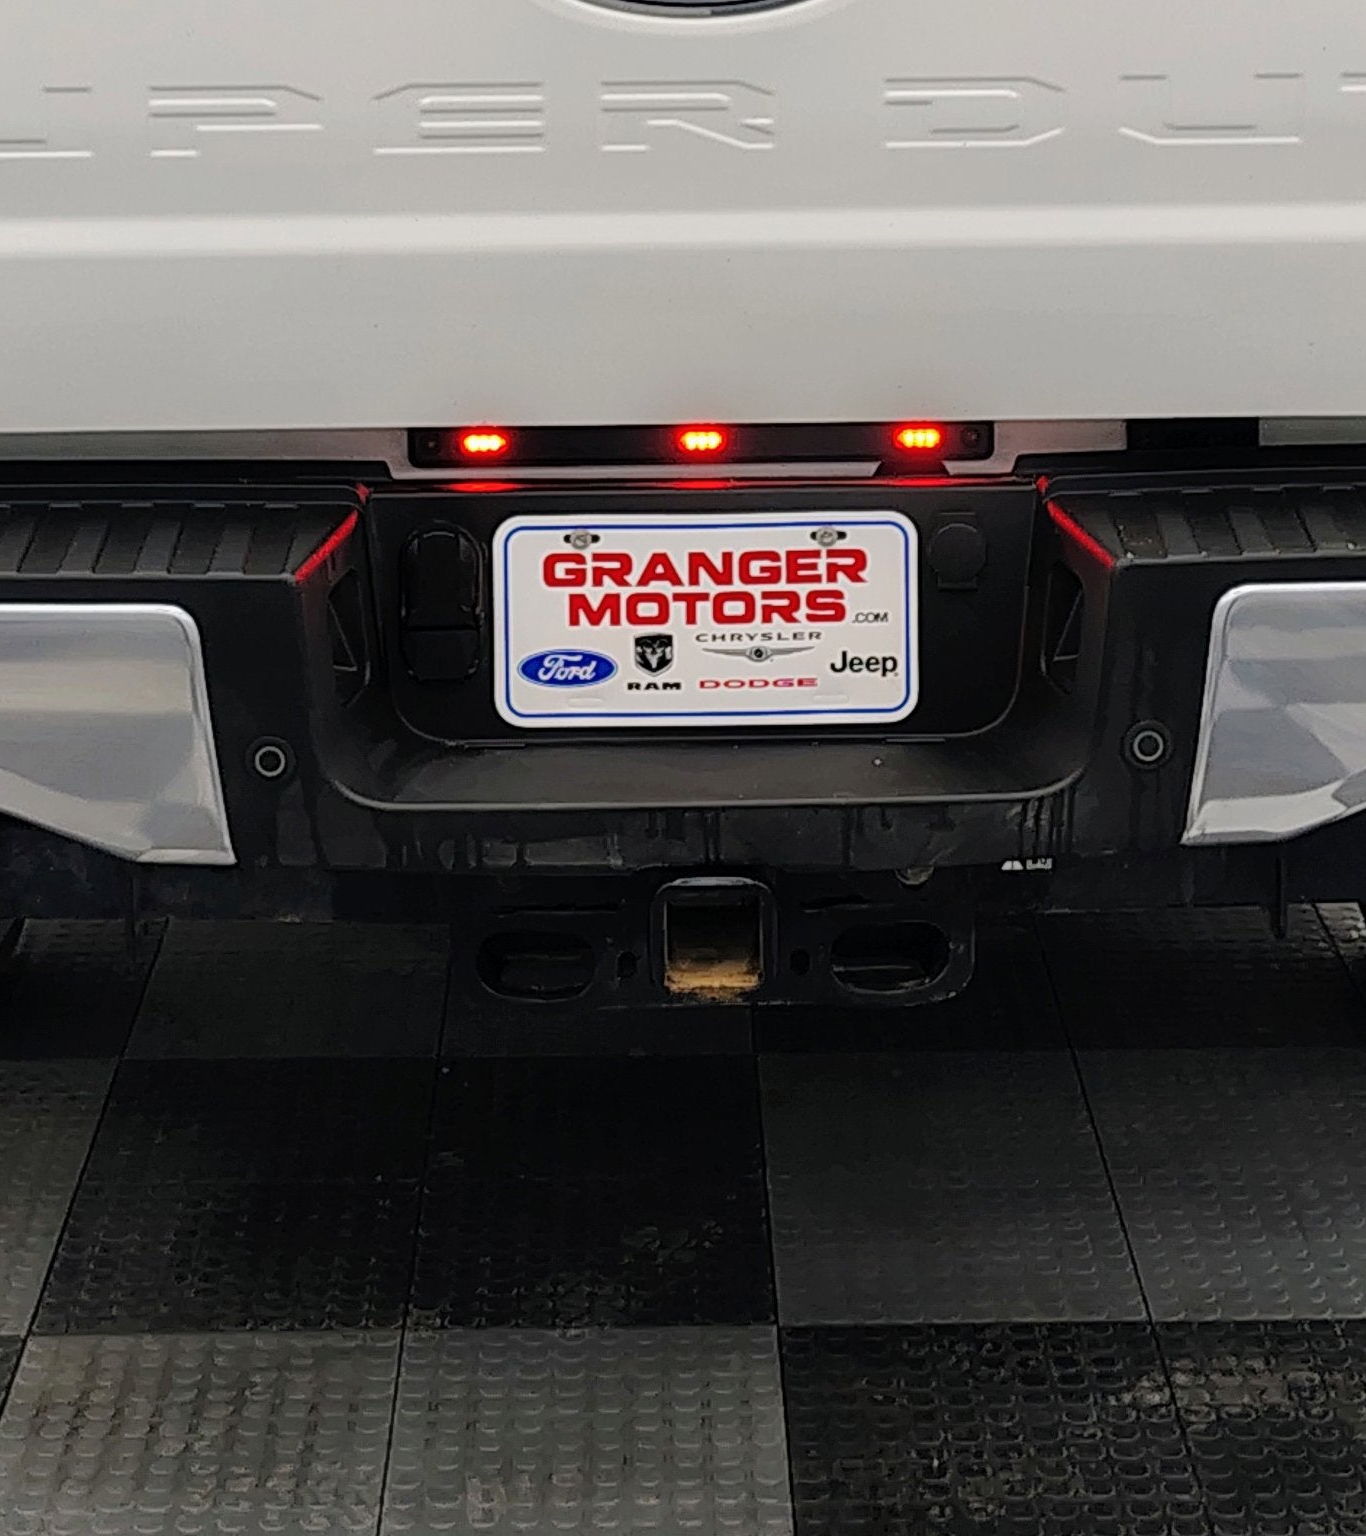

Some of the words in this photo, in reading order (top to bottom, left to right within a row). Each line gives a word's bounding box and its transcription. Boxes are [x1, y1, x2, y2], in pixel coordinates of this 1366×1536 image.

[542, 548, 869, 587] GRANGER
[568, 589, 847, 626] MOTORS
[695, 631, 823, 642] CHRYSLER
[538, 654, 597, 681] Ford
[830, 651, 898, 677] Jeep
[627, 682, 682, 691] RAM
[698, 677, 818, 689] DODGE
